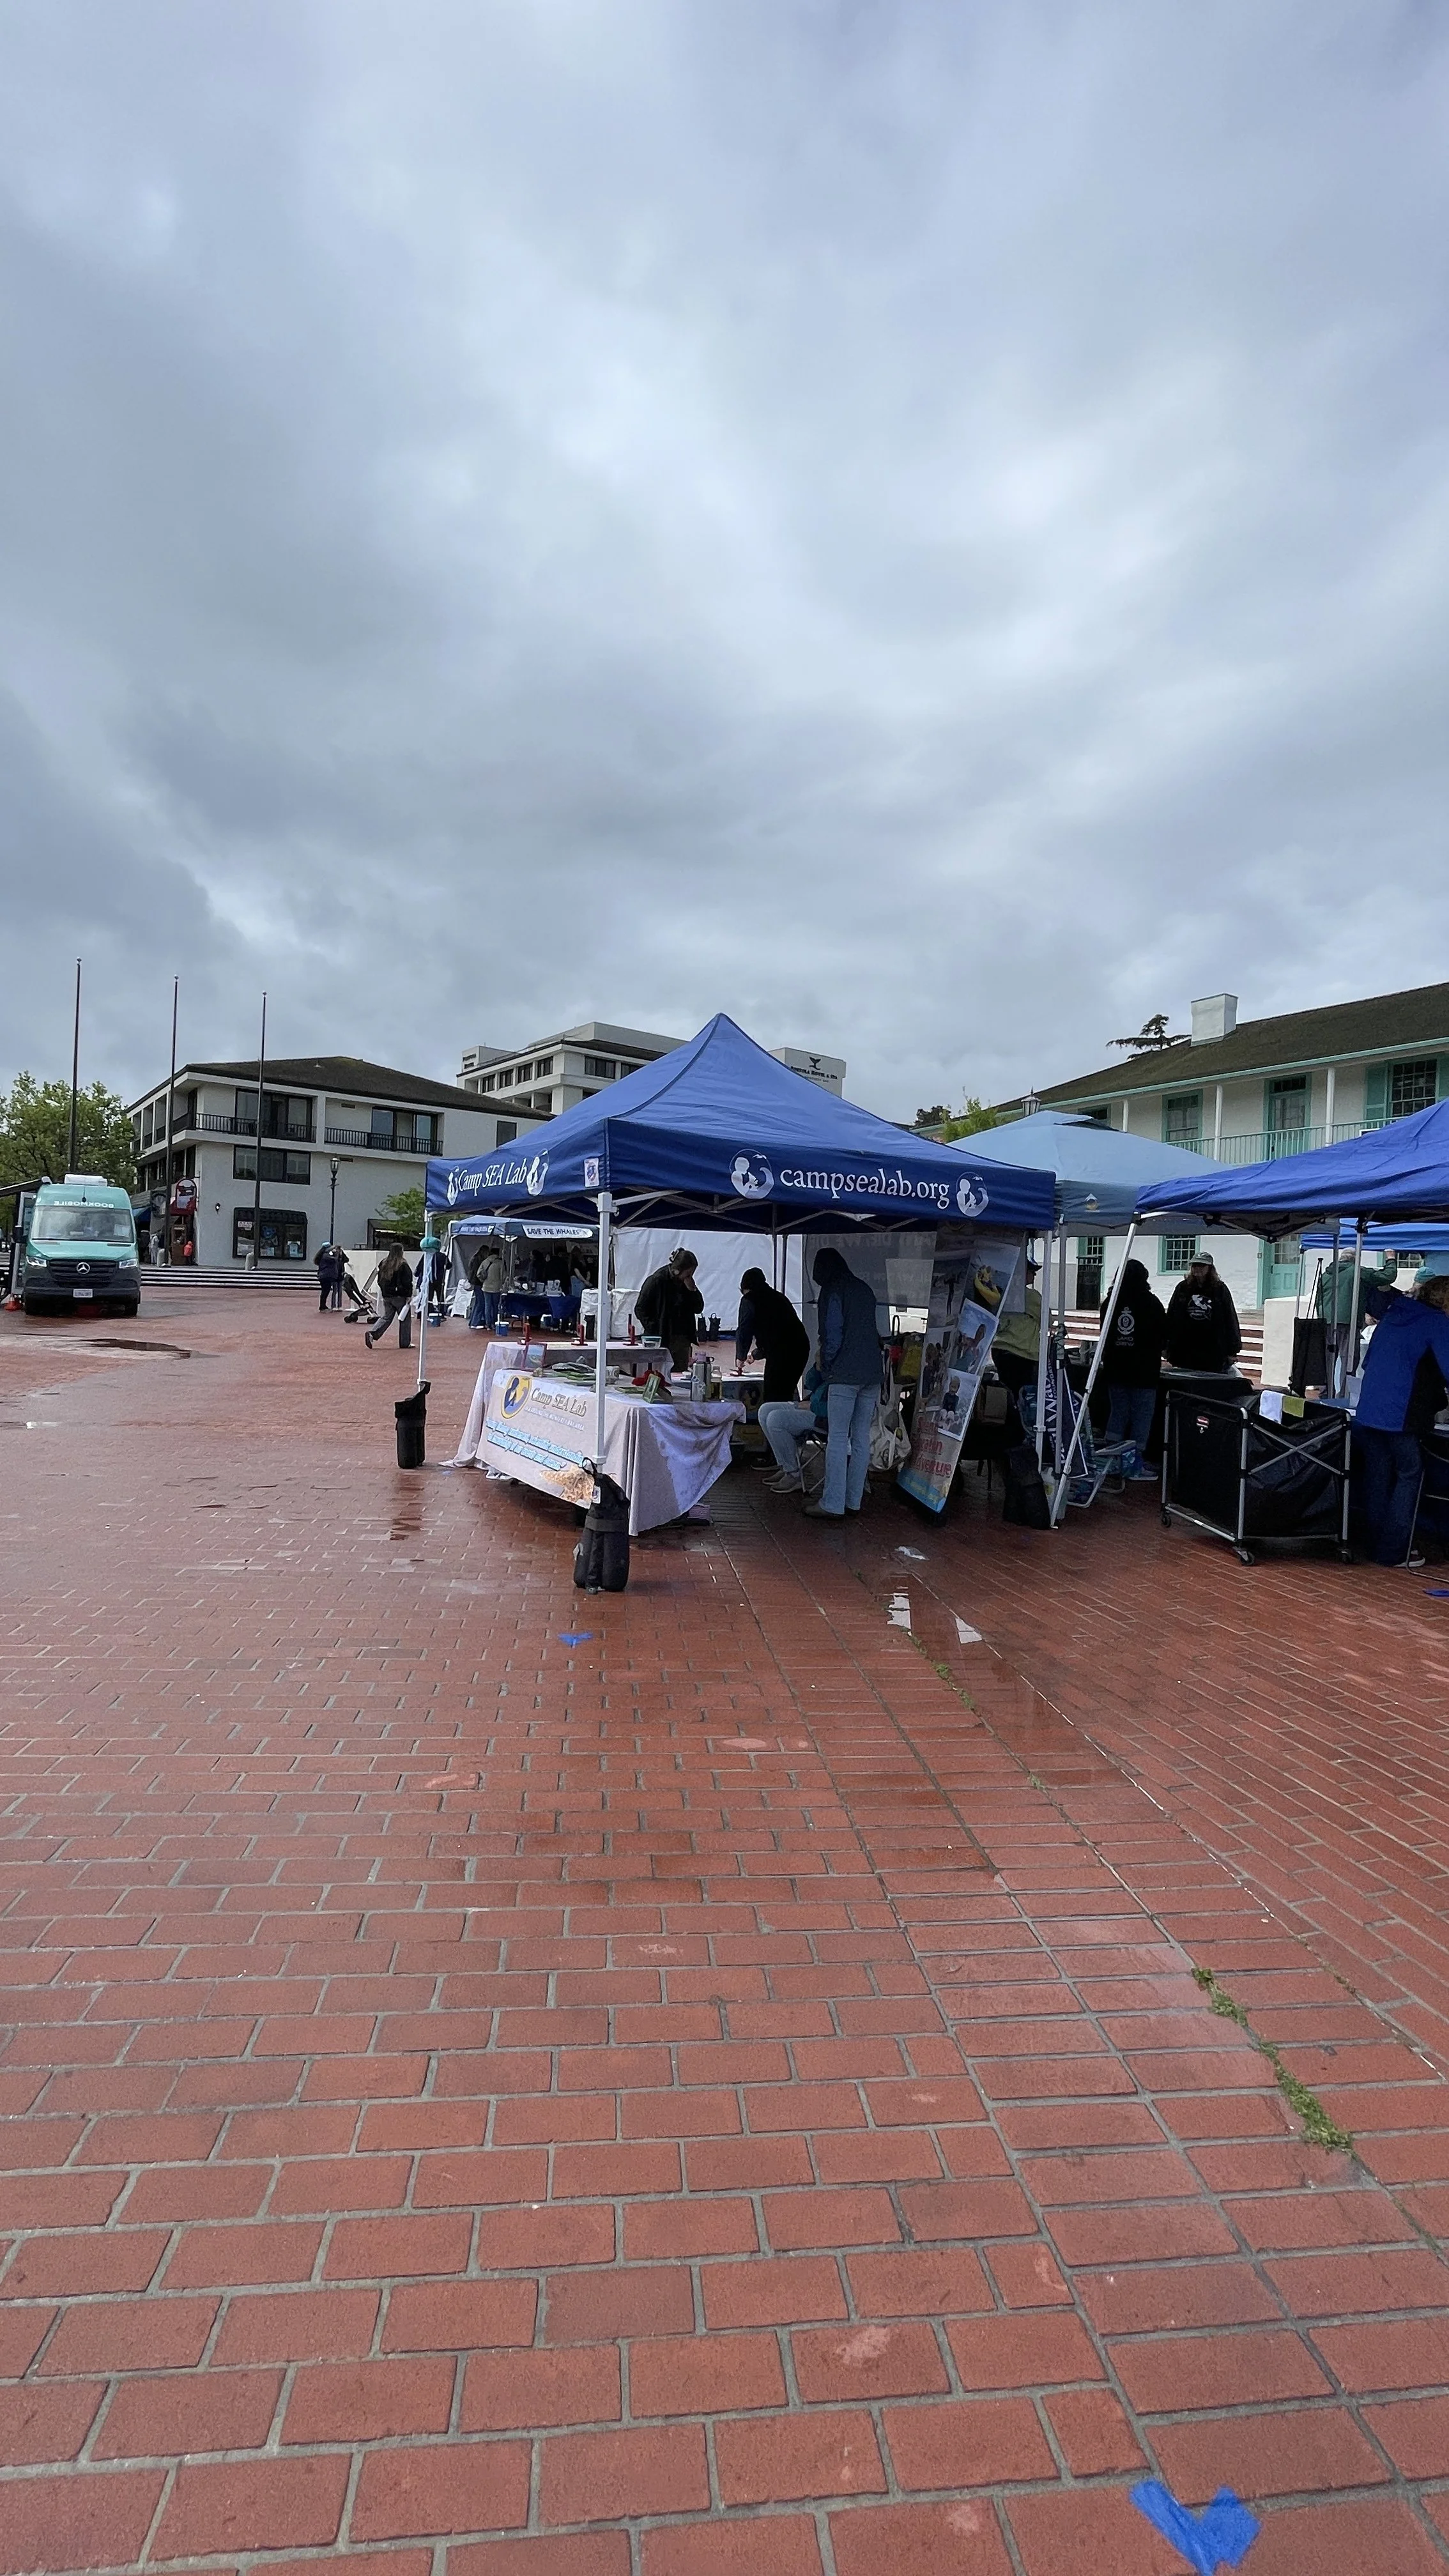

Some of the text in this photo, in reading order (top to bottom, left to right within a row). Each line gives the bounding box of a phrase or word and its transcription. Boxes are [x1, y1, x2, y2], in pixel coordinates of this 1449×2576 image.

[458, 1158, 527, 1196] Camp SEA Lab
[779, 1169, 949, 1209] campsealab.org
[531, 1388, 587, 1417] Camp SEA Lab
